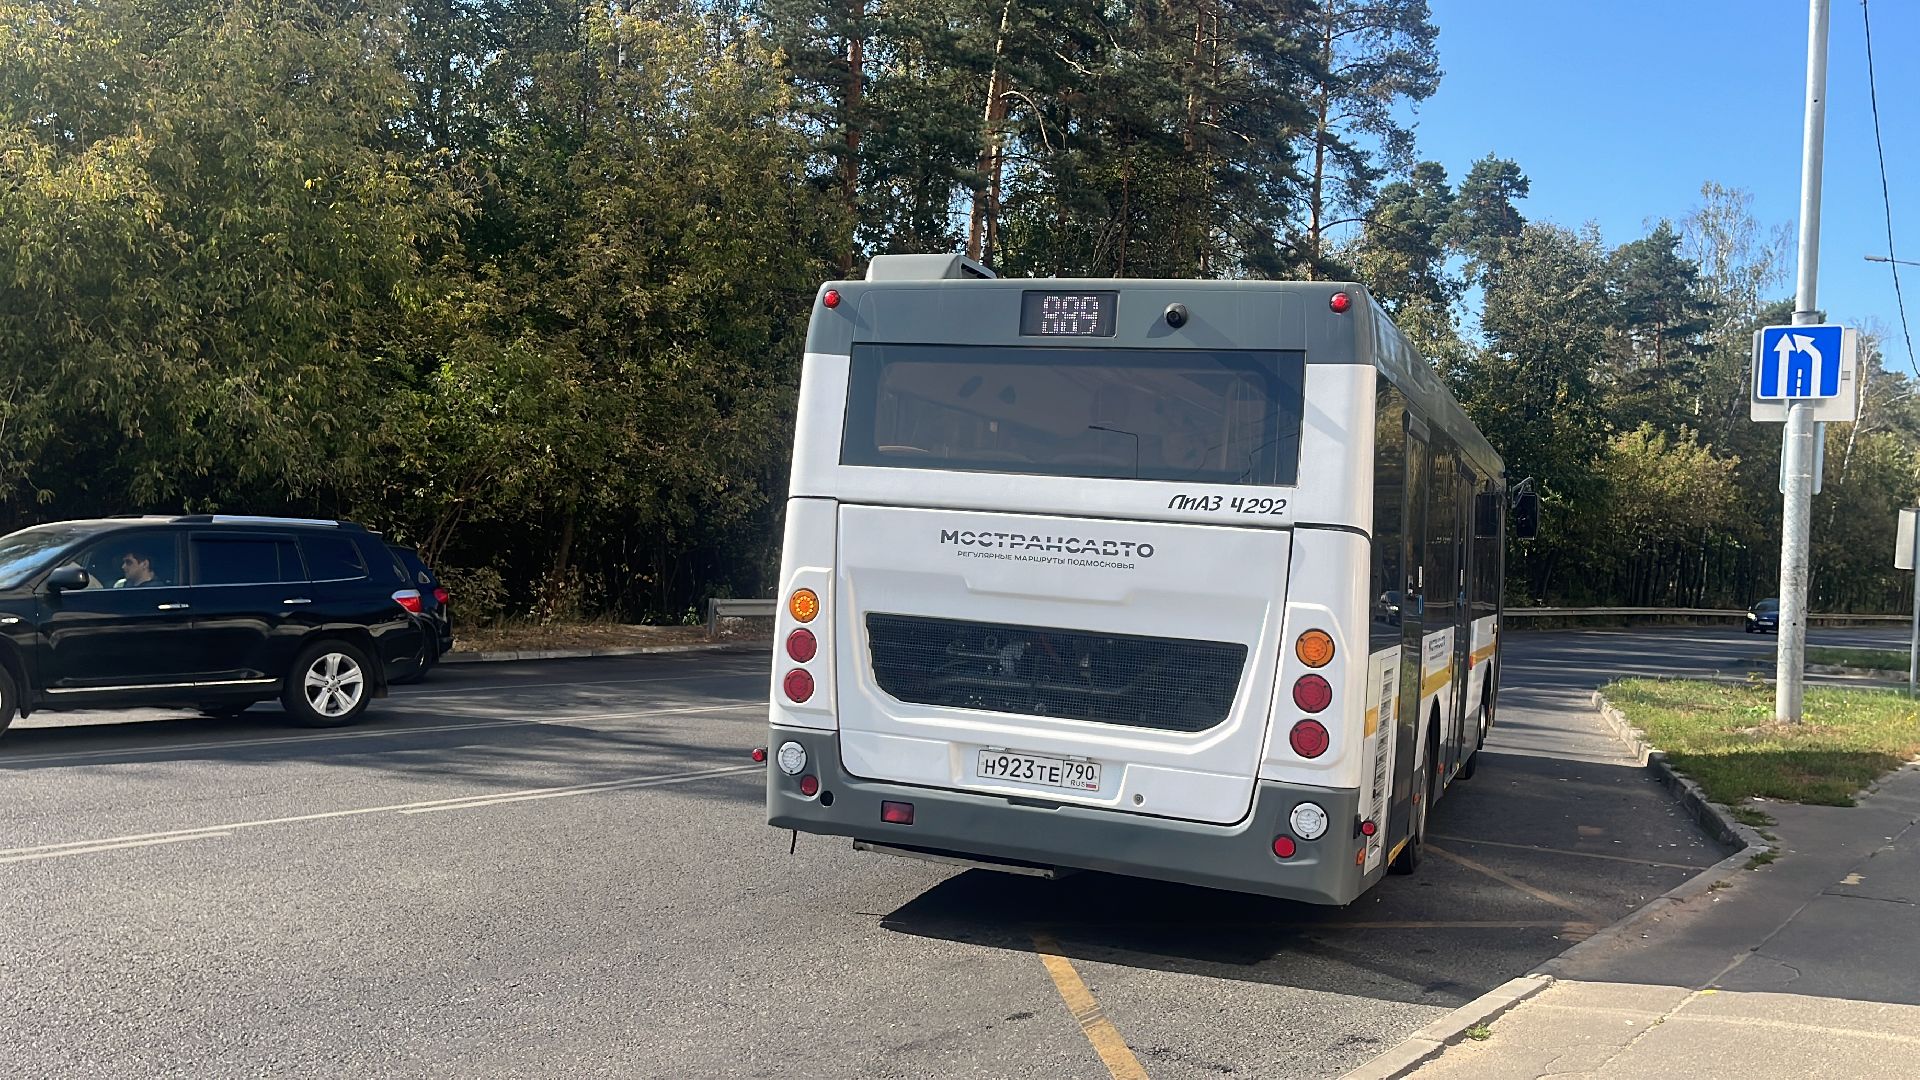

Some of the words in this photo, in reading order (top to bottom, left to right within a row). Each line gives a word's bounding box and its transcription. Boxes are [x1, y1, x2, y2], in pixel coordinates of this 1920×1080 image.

[1042, 296, 1099, 334] 889
[1167, 494, 1224, 511] ЛиАЗ
[1230, 497, 1287, 515] 4292
[940, 529, 1154, 558] МОСТРАНСАВТО
[957, 550, 1013, 560] РЕГУЛЯРНЫЕ
[1014, 555, 1066, 565] МАРШРУТЫ
[1067, 558, 1135, 570] ПОДМОСКОВЬЯ
[984, 756, 1060, 783] Н923ТЕ
[1065, 762, 1095, 781] 790
[1070, 779, 1086, 788] RUS
